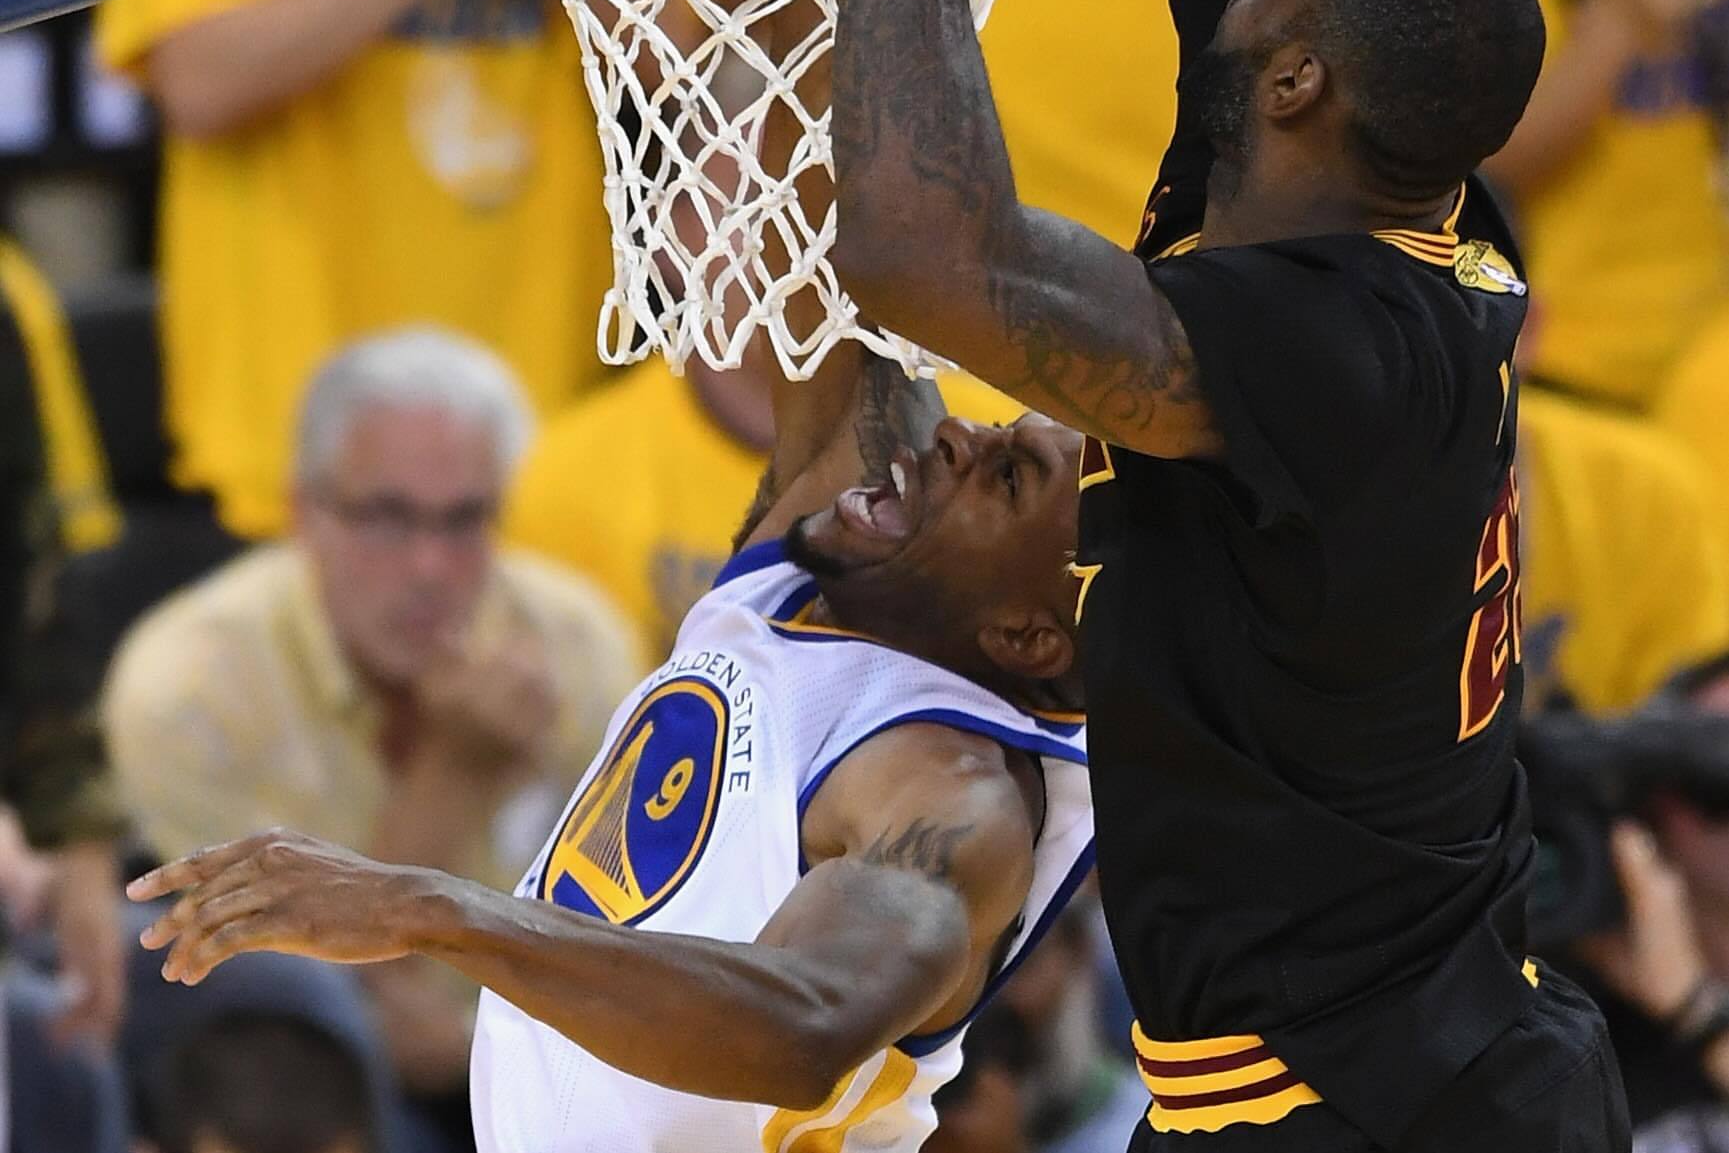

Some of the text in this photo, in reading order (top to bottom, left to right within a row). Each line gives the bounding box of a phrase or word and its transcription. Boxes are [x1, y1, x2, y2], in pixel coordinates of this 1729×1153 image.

[641, 651, 742, 697] OLDEN
[729, 687, 753, 793] STATE
[644, 757, 695, 821] 9
